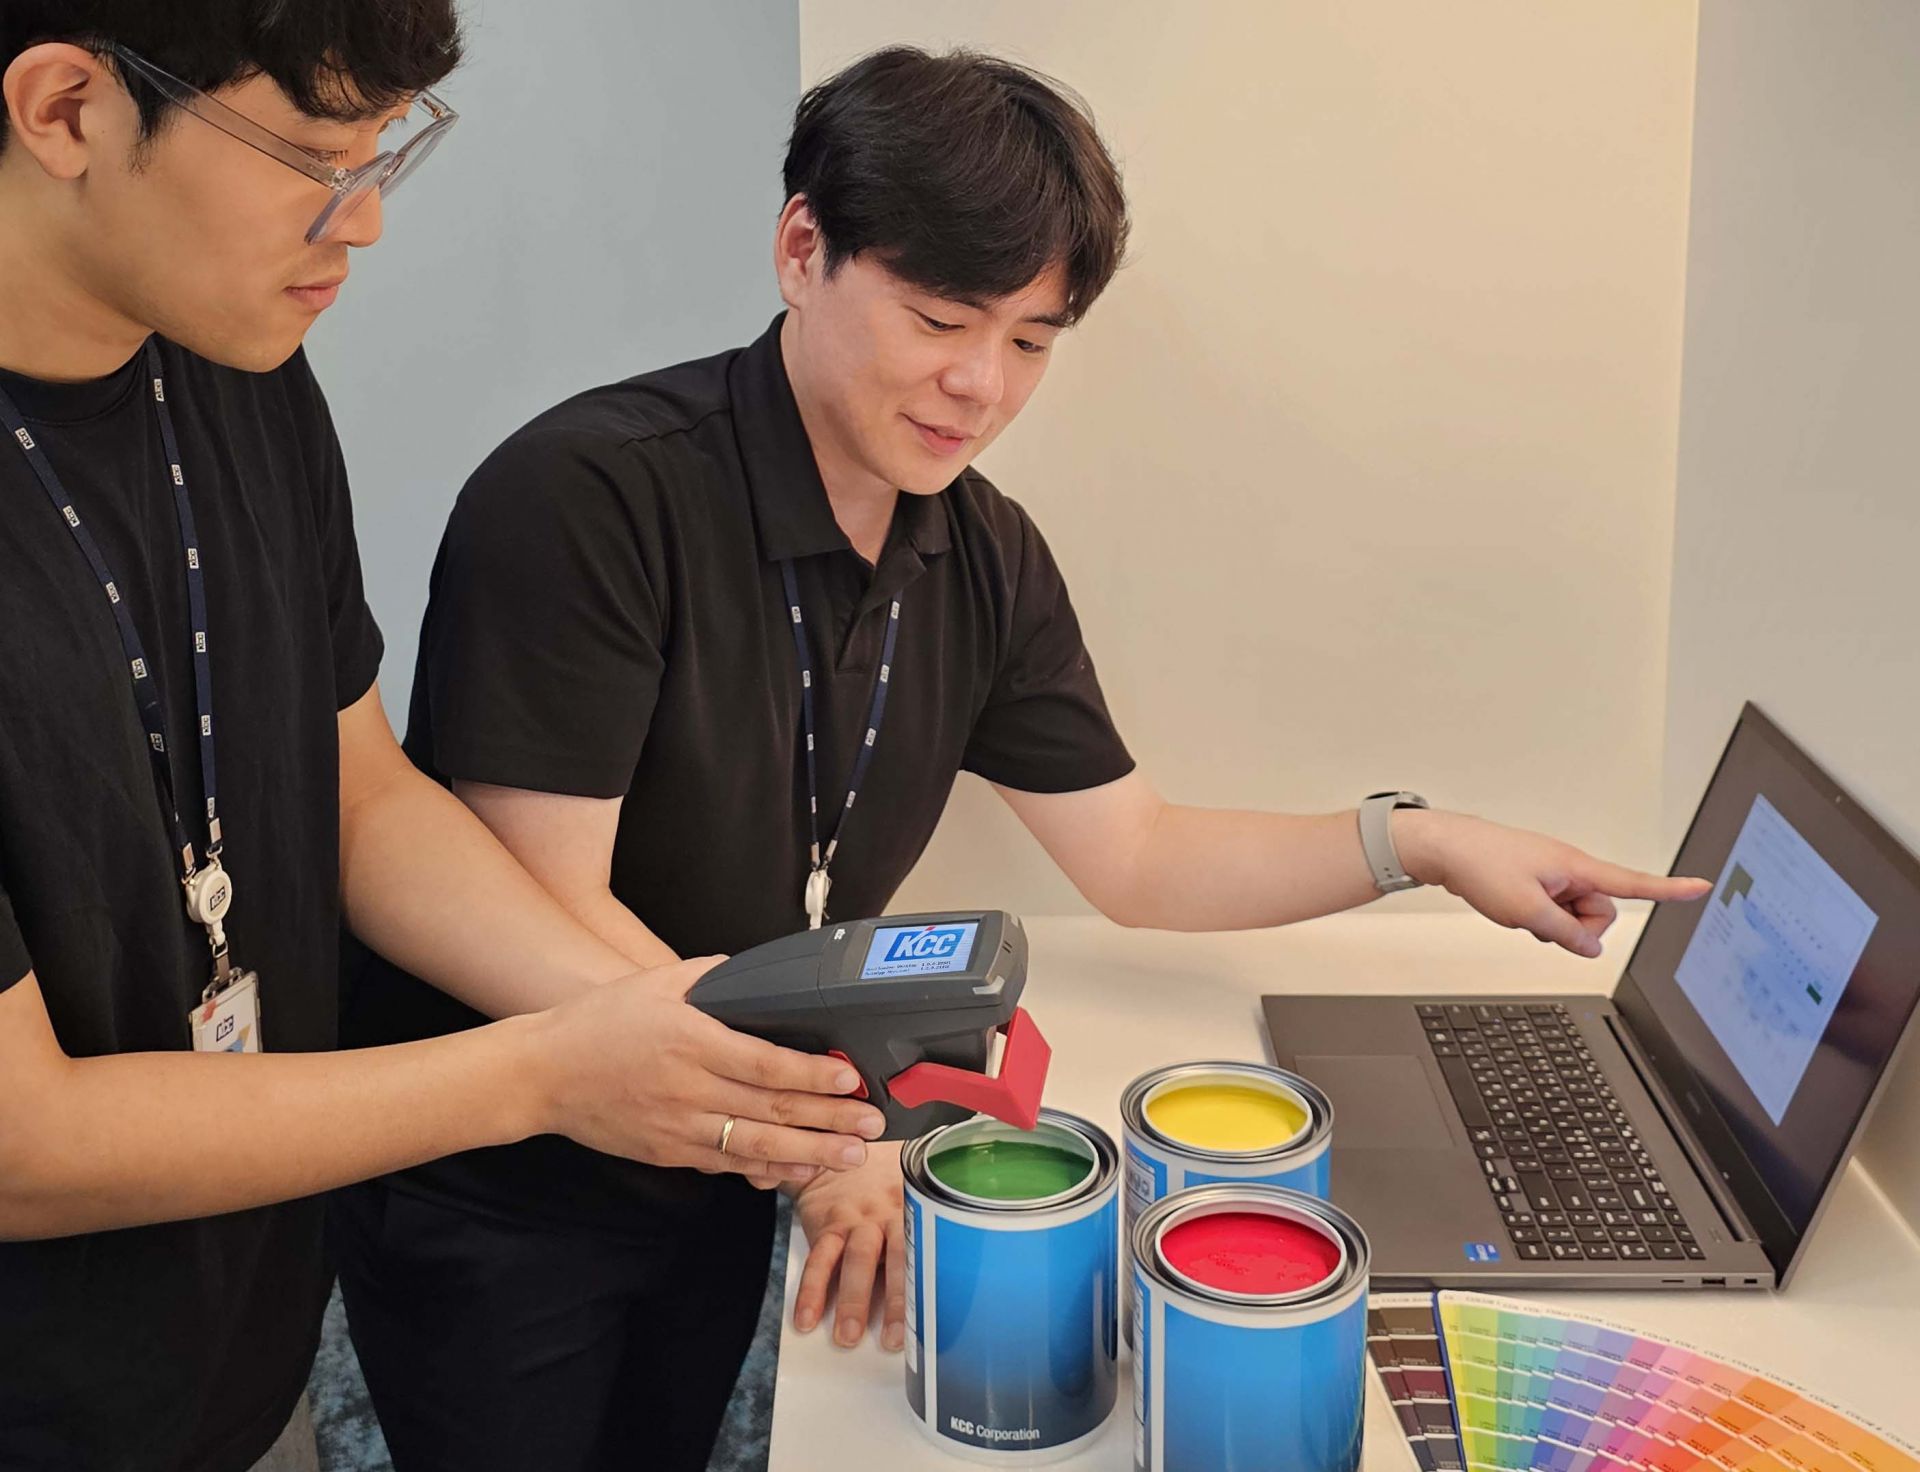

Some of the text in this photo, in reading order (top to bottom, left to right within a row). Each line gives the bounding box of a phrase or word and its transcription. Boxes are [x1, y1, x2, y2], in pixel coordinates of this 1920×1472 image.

[893, 928, 956, 958] KCC
[950, 1416, 1040, 1441] KCC Corporation
